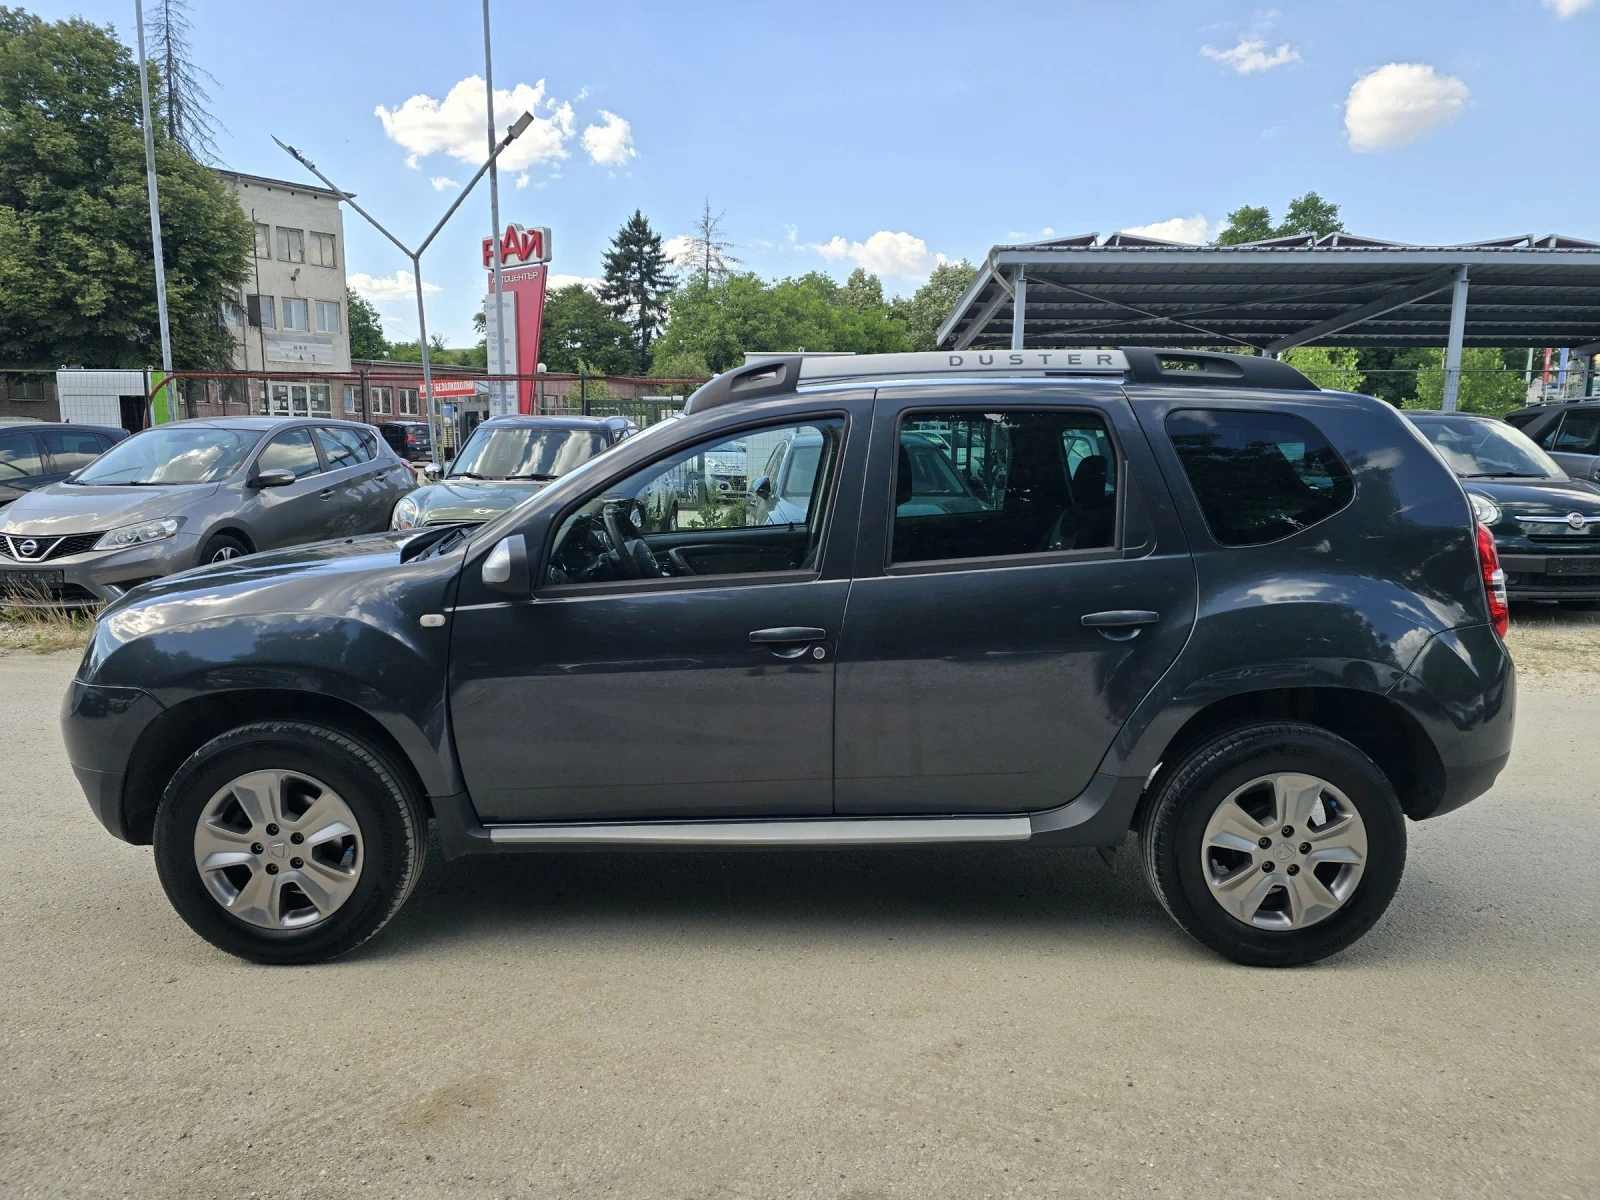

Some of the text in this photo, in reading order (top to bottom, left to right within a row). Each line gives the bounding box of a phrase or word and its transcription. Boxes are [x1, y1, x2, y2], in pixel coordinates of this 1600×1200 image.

[483, 224, 543, 266] РАЙ
[491, 271, 539, 284] АТОЦЕНТЪР
[949, 354, 1113, 367] DUSTER
